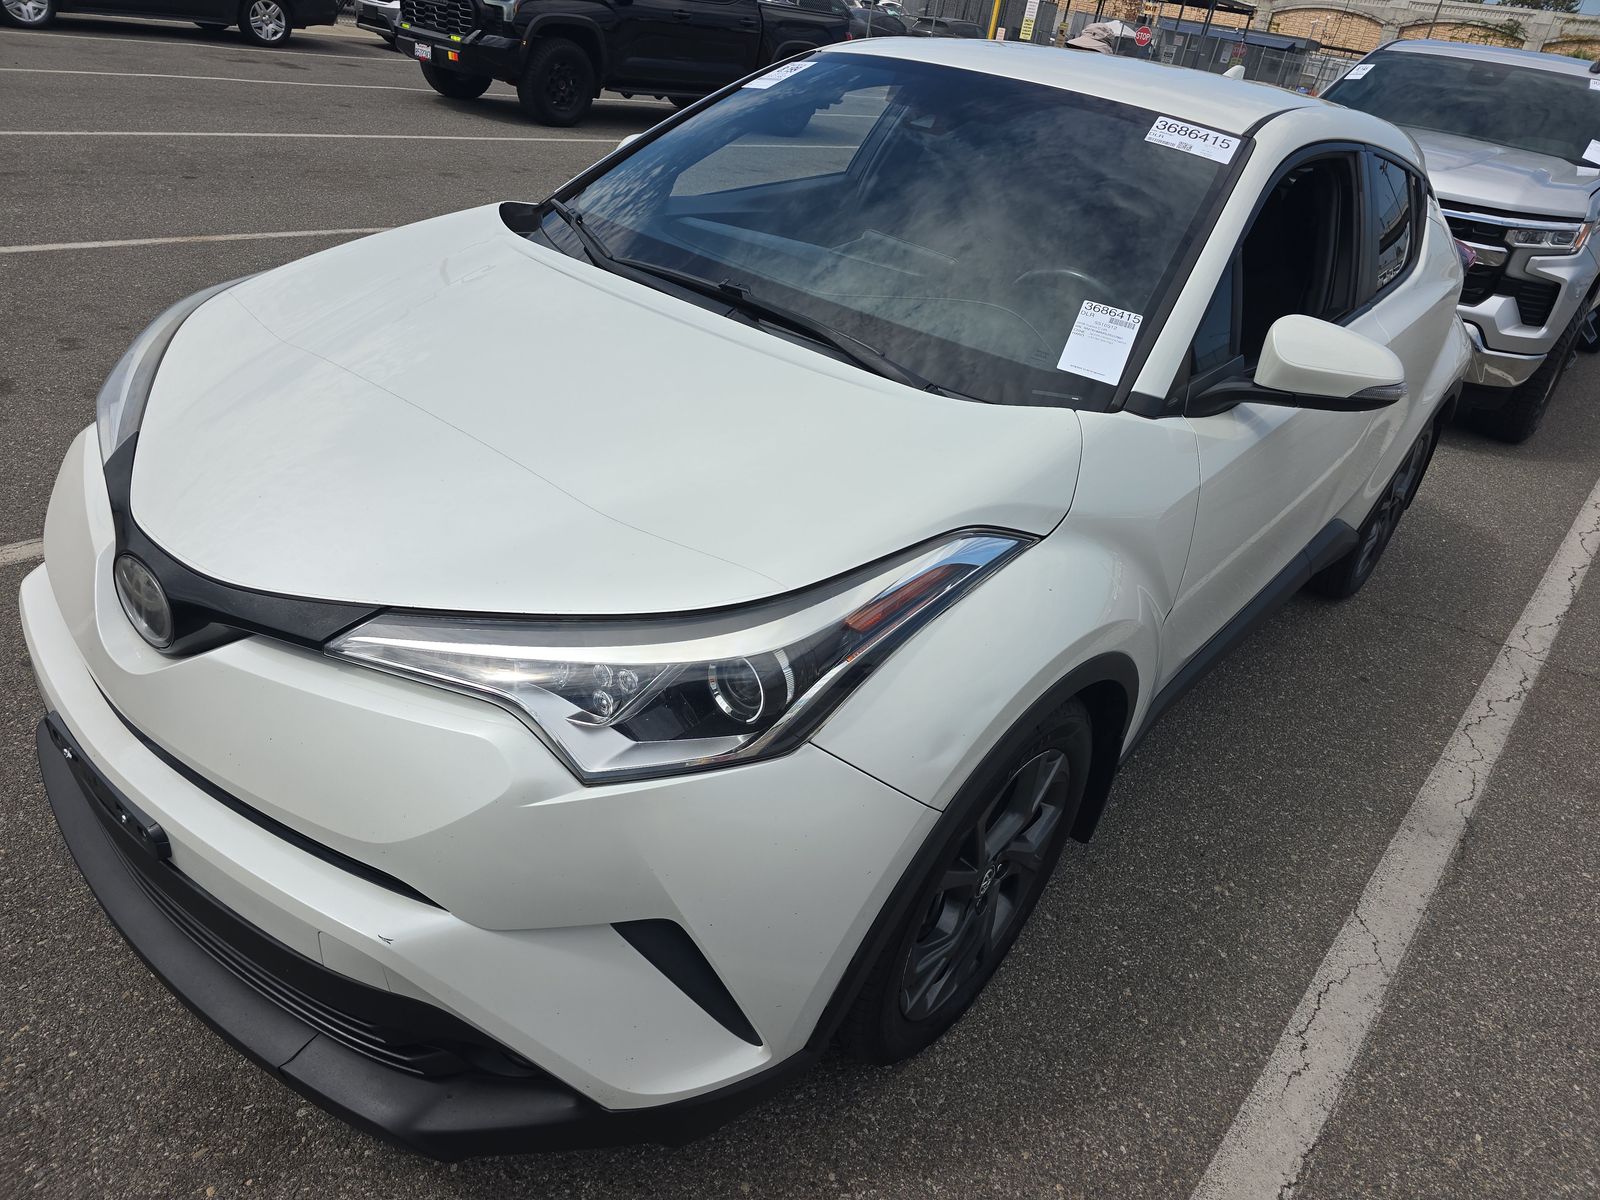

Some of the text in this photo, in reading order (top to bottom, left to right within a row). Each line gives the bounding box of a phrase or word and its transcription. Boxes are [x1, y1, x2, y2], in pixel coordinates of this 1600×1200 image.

[1136, 32, 1151, 41] STOP
[1149, 131, 1164, 139] DLR
[1156, 120, 1233, 149] 3686415
[1080, 310, 1095, 318] DLR
[1084, 302, 1141, 324] 3686415
